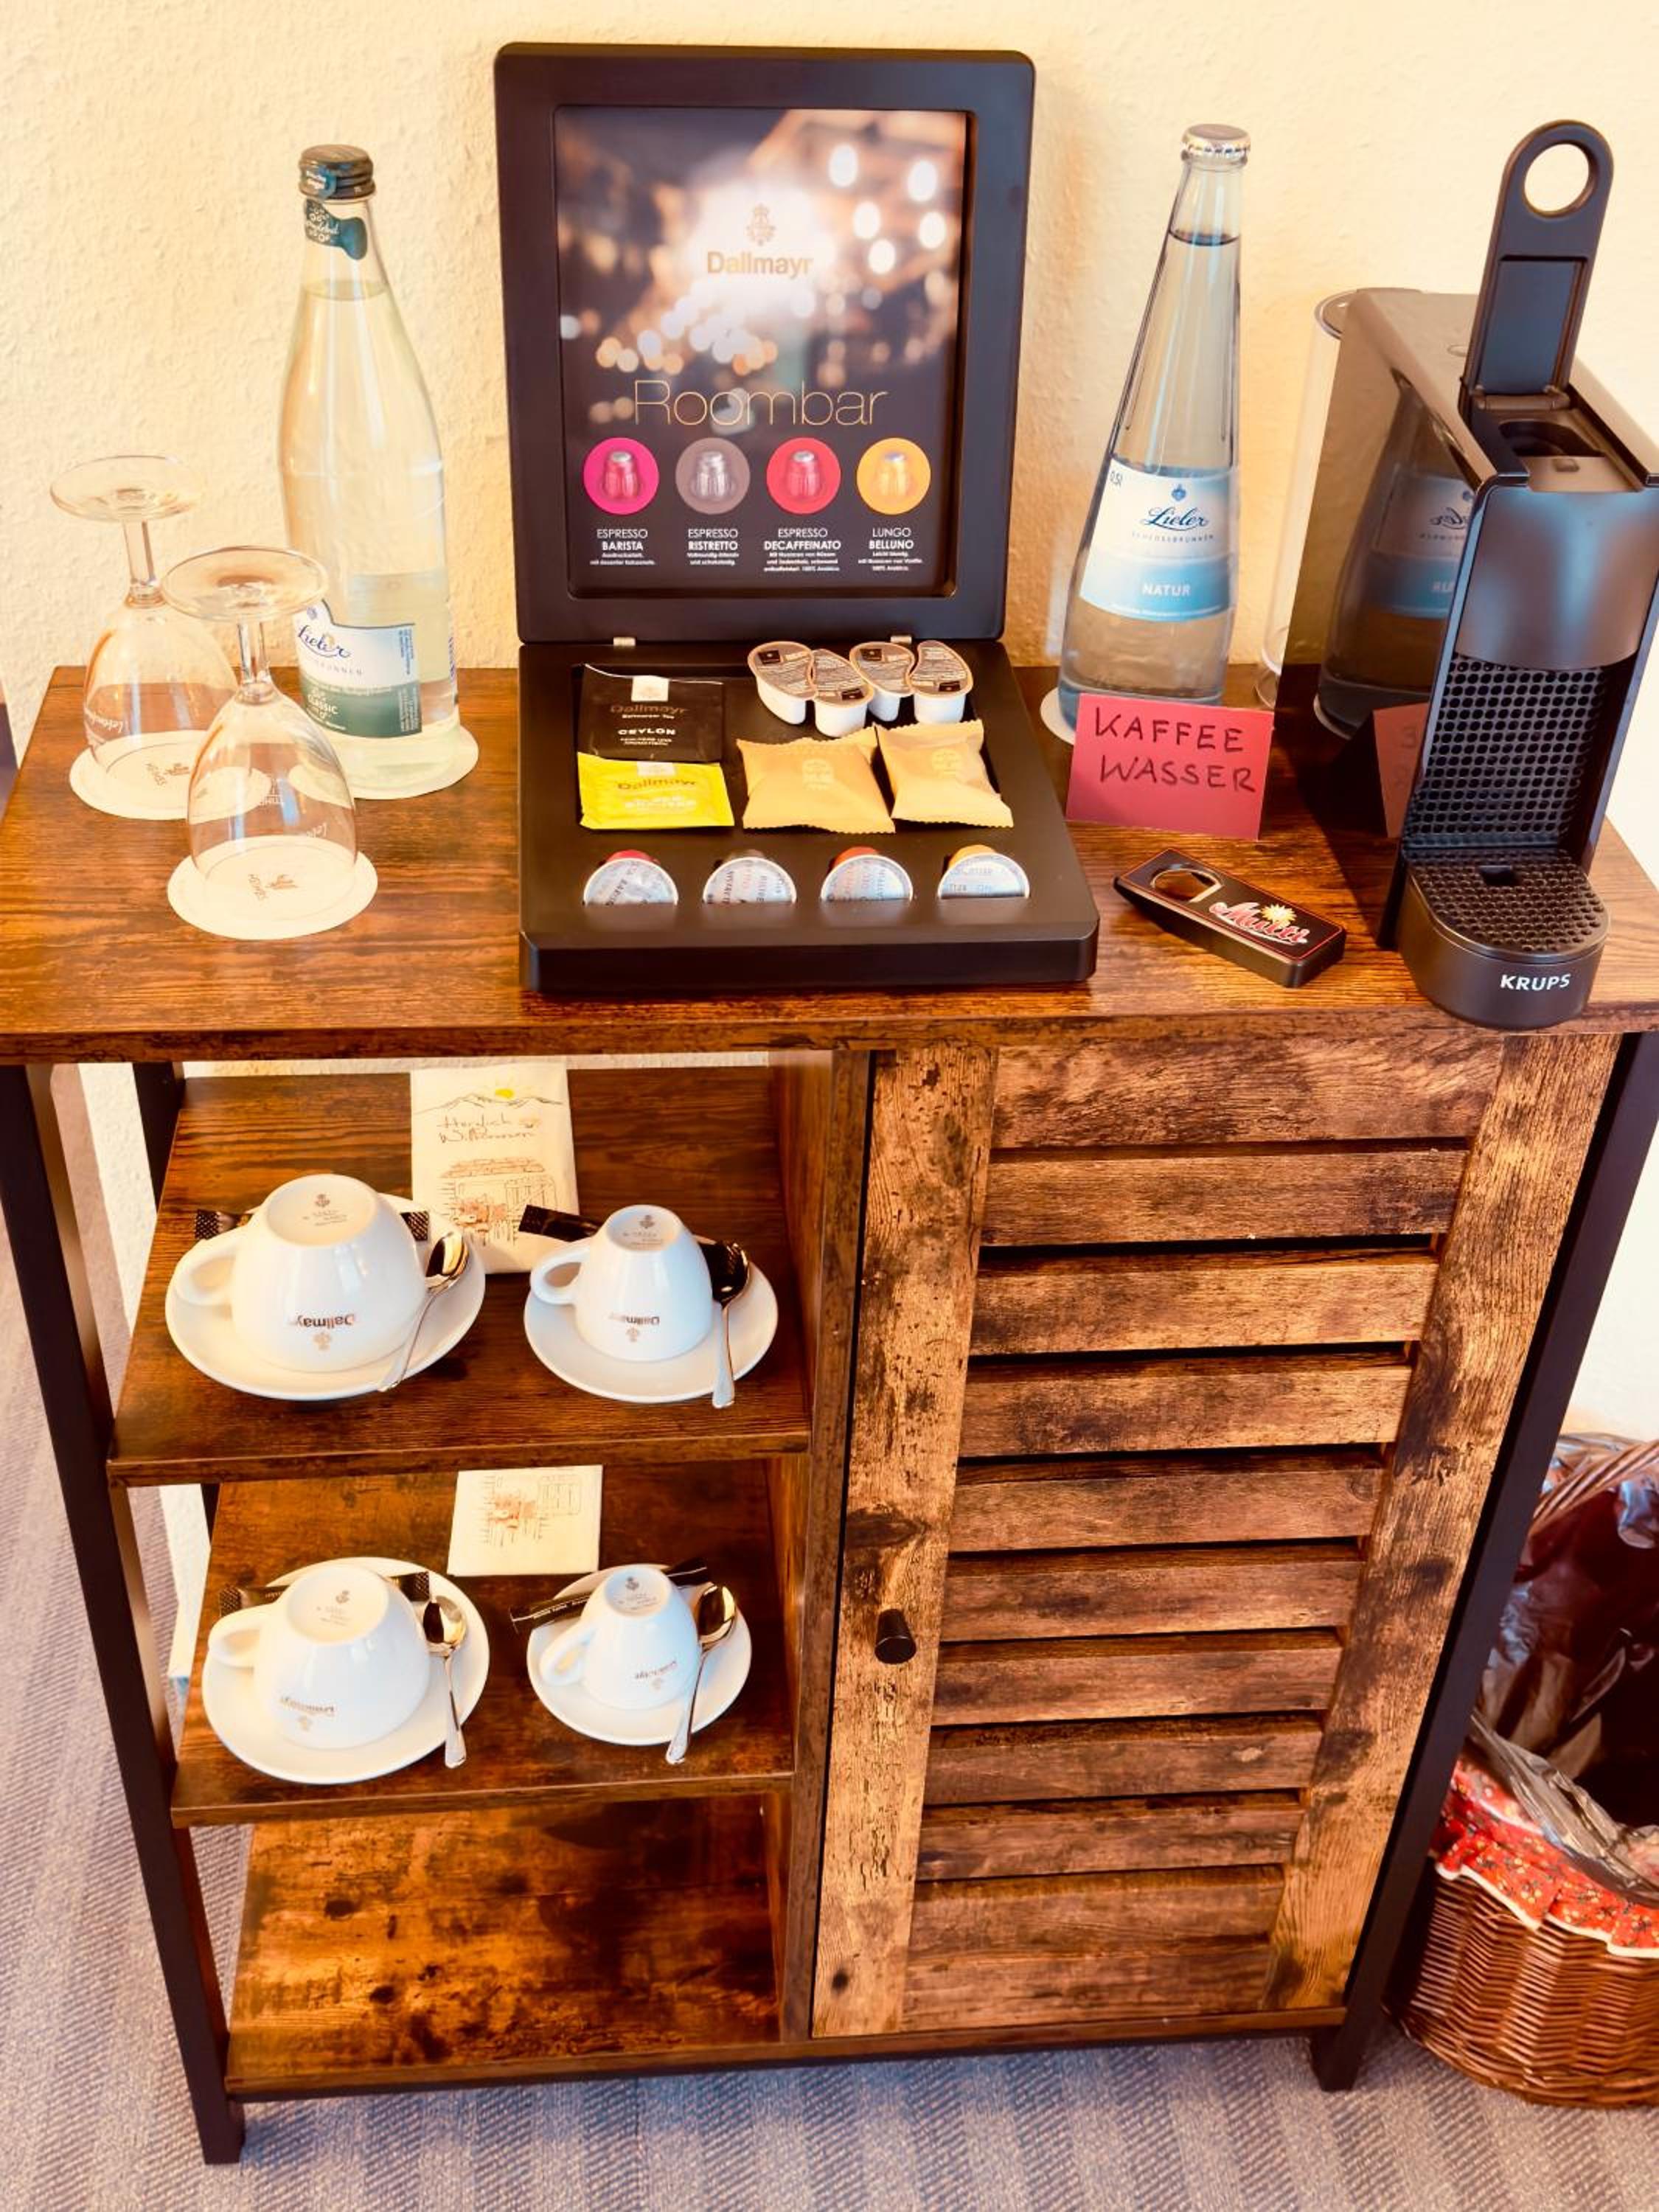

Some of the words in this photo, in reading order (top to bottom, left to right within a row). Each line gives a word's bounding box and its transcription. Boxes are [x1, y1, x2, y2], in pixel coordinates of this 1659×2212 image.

[706, 251, 813, 279] Dallmayr
[633, 380, 889, 425] Roombar
[597, 528, 648, 539] ESPRESSO
[688, 528, 738, 539] ESPRESSO
[778, 527, 828, 538] ESPRESSO
[872, 527, 911, 538] LUNGO
[602, 540, 644, 551] BARISTA
[688, 540, 738, 551] RISTRETTO
[764, 540, 841, 551] DECAFFEINATO
[869, 540, 914, 550] BELLUNO
[1141, 582, 1191, 597] NATUR
[610, 704, 686, 714] Dallmayr
[617, 728, 676, 736] CEYLON
[1094, 706, 1245, 754] KAFFEE
[1099, 754, 1257, 793] WASSER
[1500, 973, 1572, 991] KRUPS
